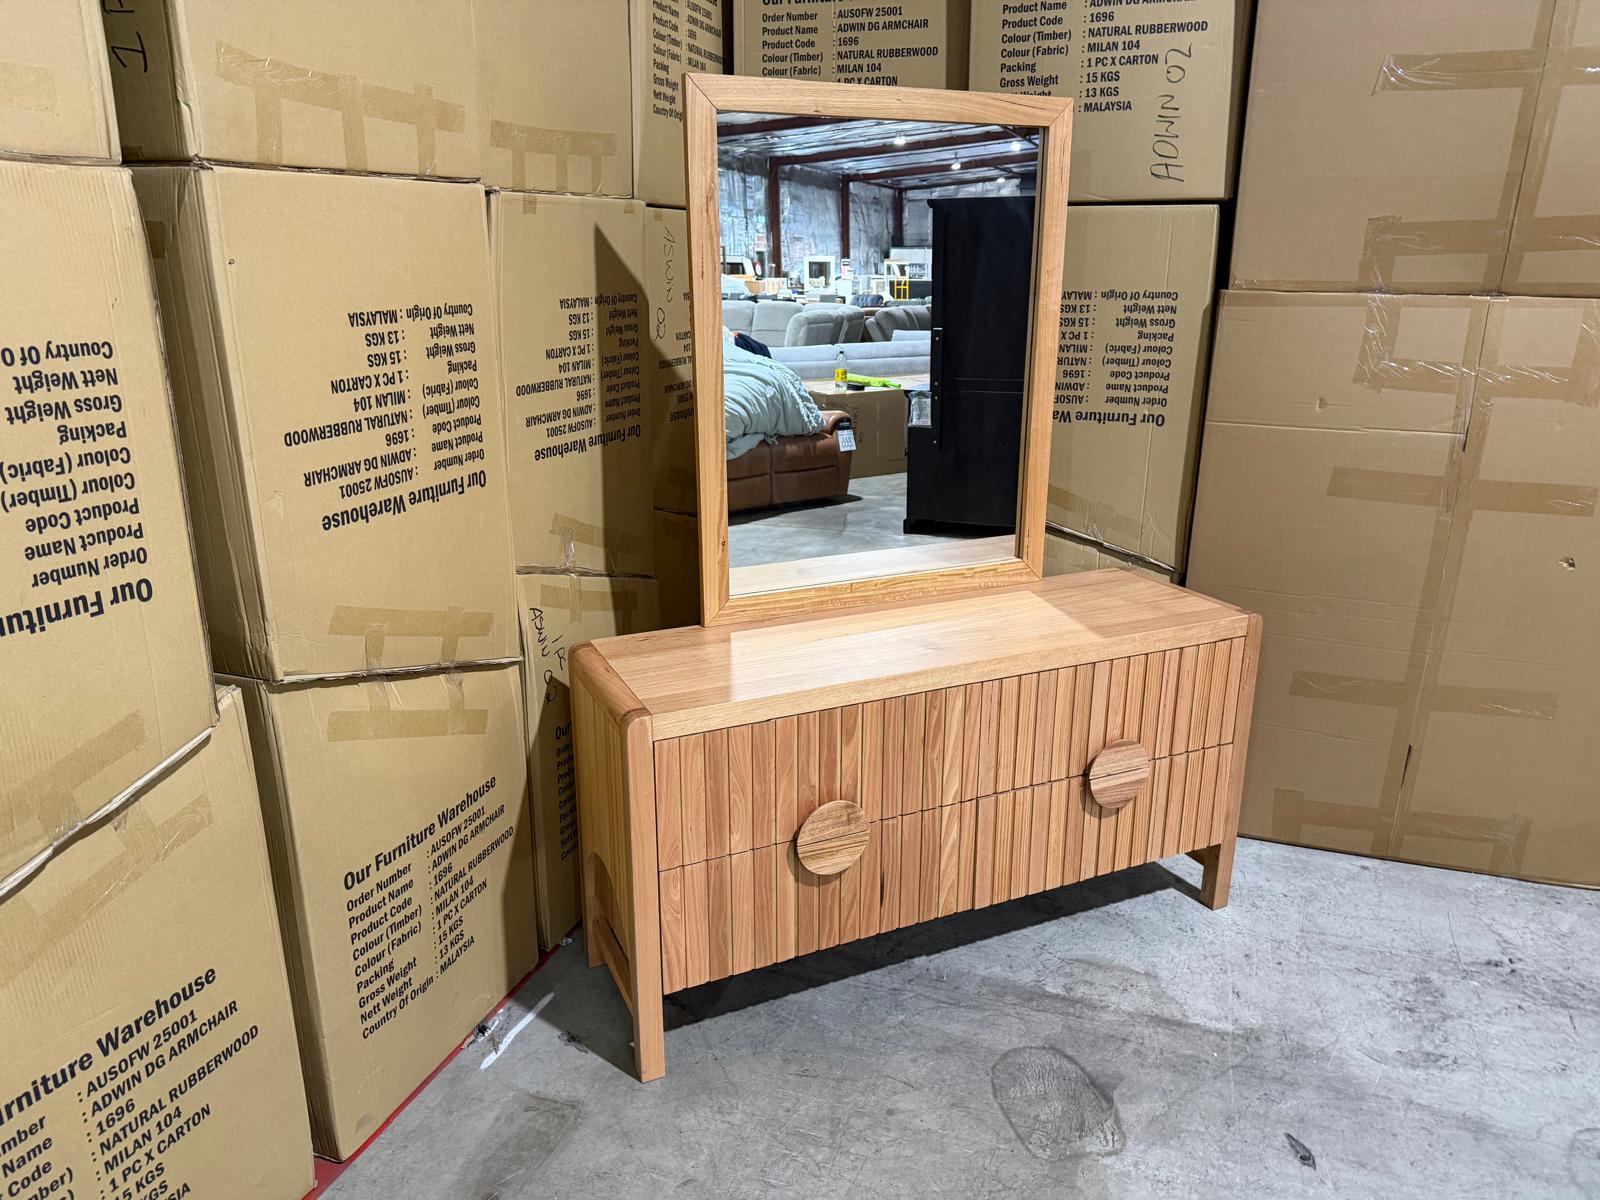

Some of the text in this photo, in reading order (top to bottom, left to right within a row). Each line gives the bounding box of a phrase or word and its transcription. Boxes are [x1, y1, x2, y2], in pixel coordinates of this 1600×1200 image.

[762, 6, 903, 23] Order Number AUSOFW 25001
[1002, 0, 1067, 14] Product Name
[1002, 11, 1114, 29] Product Code 1696
[762, 18, 928, 36] Product Name ADWIN DG ARMCHAIR
[1001, 20, 1208, 44] Colour (Timber) NATURAL RUBBERWOOD
[761, 46, 938, 64] Colour (Timber) NATURAL RUBBERWOOD
[762, 36, 859, 50] Product Code 1696
[1000, 39, 1140, 58] Colour (Fabric) MILAN 104
[761, 62, 881, 78] Colour (Fabric) MILAN 104
[1000, 53, 1158, 73] Packing 1 PC X CARTON
[999, 70, 1120, 88] Gross Weight 15 KGS
[1085, 86, 1119, 98] 13 KGS
[1083, 100, 1132, 112] MALAYSIA
[1150, 94, 1185, 183] ADWIN
[559, 297, 589, 309] MALAYSIA
[1100, 289, 1178, 301] Country Of Origin
[347, 302, 473, 327] Country Of Origin MALAYSIA
[19, 340, 113, 366] Country Of
[12, 367, 118, 394] Nett Weight
[515, 373, 591, 396] NATURAL RUBBERWOOD
[1054, 381, 1168, 394] Product Name ADWIN
[1062, 369, 1170, 381] Product Code 1696
[353, 377, 478, 412] Colour (Fabric) MILAN 104
[1104, 395, 1167, 407] Order Number
[4, 394, 122, 425] Gross Weight
[284, 395, 480, 447] Colour (Timber) NATURAL RUBBERWOOD
[525, 403, 592, 428] ADWIN DG ARMCHAIR
[1075, 410, 1165, 427] Our Furniture
[56, 421, 127, 445] Packing
[385, 413, 481, 447] Product Code 1696
[546, 418, 593, 438] AUSOFW 25001
[303, 431, 483, 487] Product Name ADWIN DG ARMCHAIR
[534, 438, 587, 461] Warehouse
[0, 446, 131, 484] Colour (Fabric)
[339, 448, 484, 499] Order Number AUSOFW 25001
[0, 472, 135, 513] Colour (Timber)
[322, 469, 486, 531] Our Furniture Warehouse
[25, 497, 140, 535] Product Code
[24, 522, 144, 561] Product Name
[31, 547, 147, 588] Order Number
[0, 578, 153, 637] Our Furnitu
[343, 776, 496, 890] Our Furniture Warehouse
[346, 805, 485, 912] Order Number AUSOFW 25001
[348, 804, 504, 929] Product Name ADWIN DG ARMCHAIR
[352, 826, 513, 961] Colour (Timber) NATURAL RUBBERWOOD
[95, 968, 216, 1057] Warehouse
[86, 1009, 197, 1098] AUSOFW 25001
[1, 1000, 238, 1179] Name ADWIN DG ARMCHAIR
[99, 1025, 258, 1156] NATURAL RUBBERWOOD
[7, 1098, 135, 1198] Code 1696
[103, 1105, 182, 1175] MILAN 104
